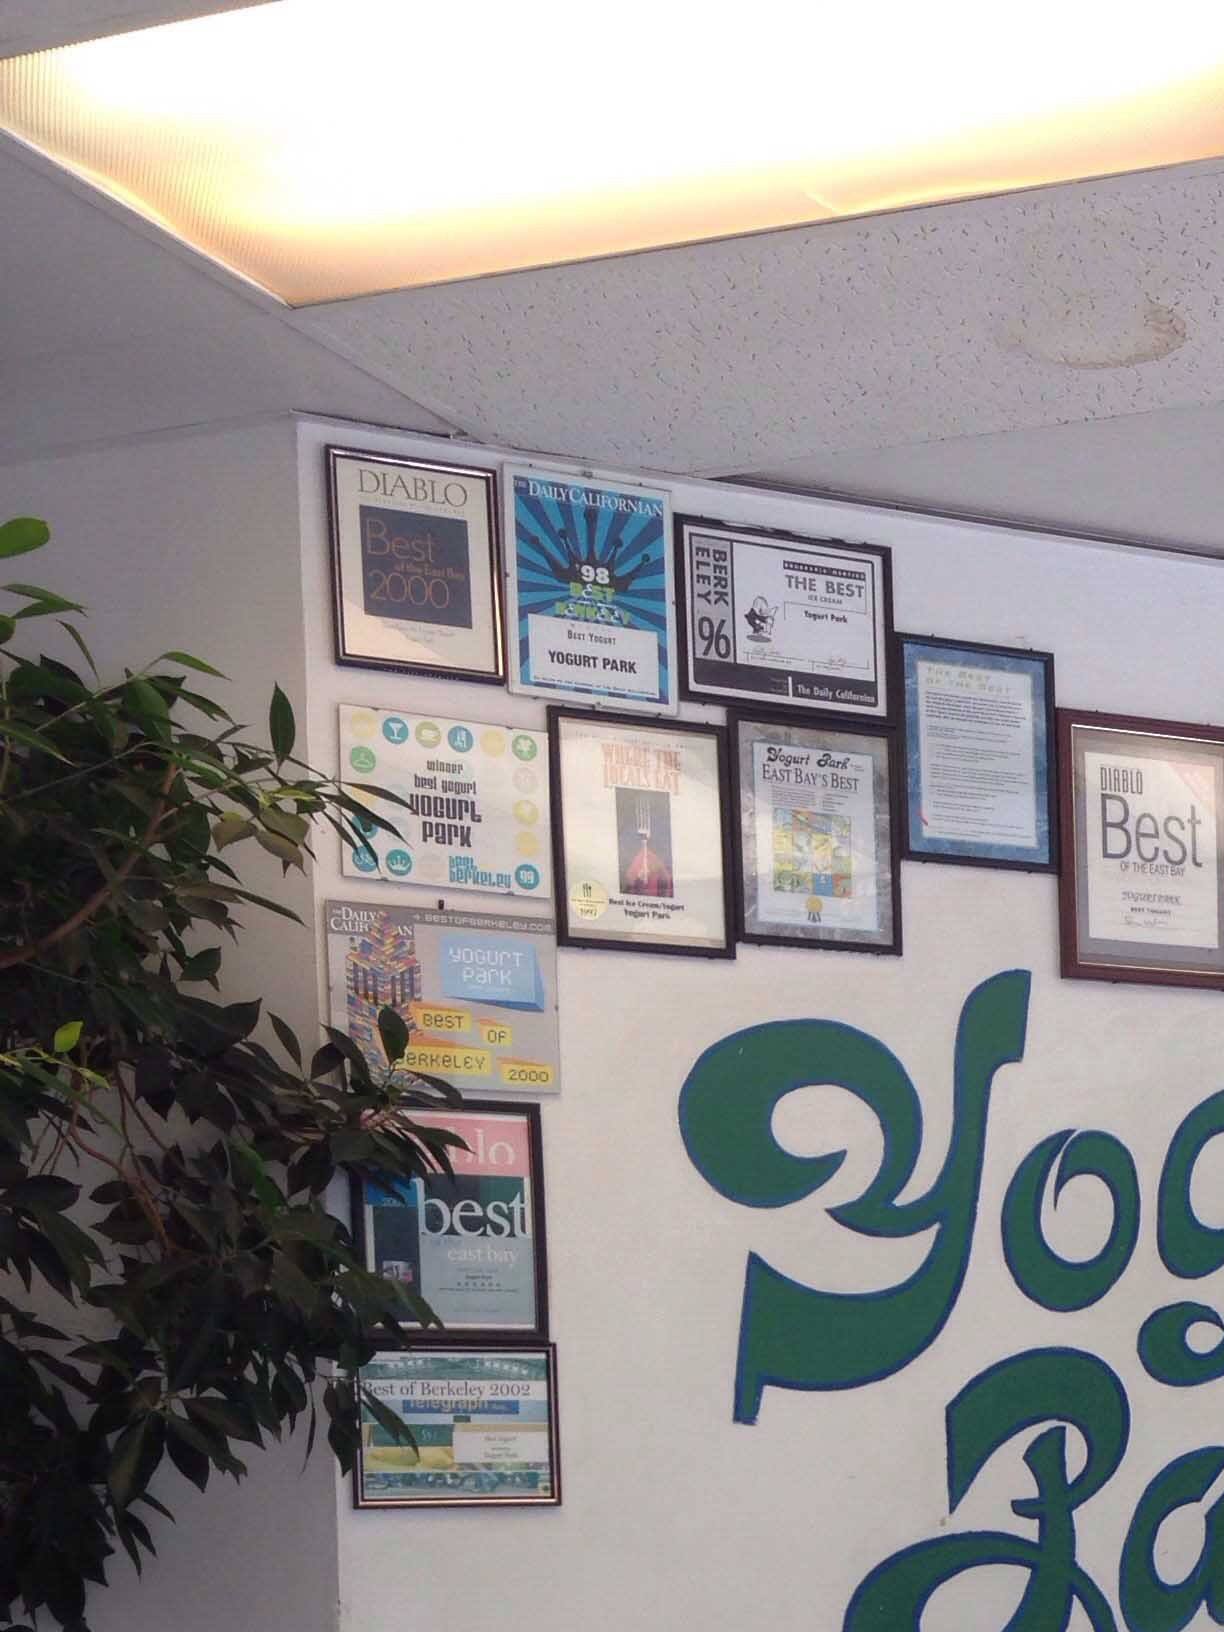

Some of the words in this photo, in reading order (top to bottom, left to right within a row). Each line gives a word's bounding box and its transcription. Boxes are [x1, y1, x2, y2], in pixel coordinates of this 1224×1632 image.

[359, 469, 468, 507] DIABLO
[529, 480, 570, 500] DAILY
[570, 485, 663, 517] CALIFORNIAN
[366, 519, 435, 562] Best
[576, 564, 610, 584] '98
[713, 550, 729, 607] BERK
[369, 569, 449, 608] 2000
[785, 575, 817, 592] THE
[826, 581, 864, 598] BEST
[804, 610, 828, 621] Yogurt
[830, 614, 848, 624] Park
[589, 633, 616, 645] YOGURT
[699, 616, 731, 659] 96
[549, 650, 598, 668] YOGURT
[603, 658, 637, 674] PARK
[798, 684, 810, 695] The
[814, 686, 832, 699] Daily
[836, 689, 875, 703] Californian
[427, 760, 464, 775] winner
[767, 747, 811, 767] Yogurt
[817, 753, 850, 769] Park
[414, 774, 437, 790] best
[762, 764, 793, 782] EAST
[831, 772, 860, 792] BEST
[1100, 766, 1143, 795] DIABLO
[1101, 793, 1202, 868] Best
[1133, 863, 1147, 873] THE
[1150, 864, 1169, 876] EAST
[1170, 866, 1185, 877] BAY
[342, 907, 377, 922] DAILY
[487, 1030, 507, 1044] OF
[508, 1069, 549, 1082] 2000
[416, 1178, 531, 1238] best
[362, 1383, 395, 1396] Best
[401, 1381, 416, 1396] of
[421, 1382, 485, 1397] Berkeley
[490, 1383, 531, 1396] 2002
